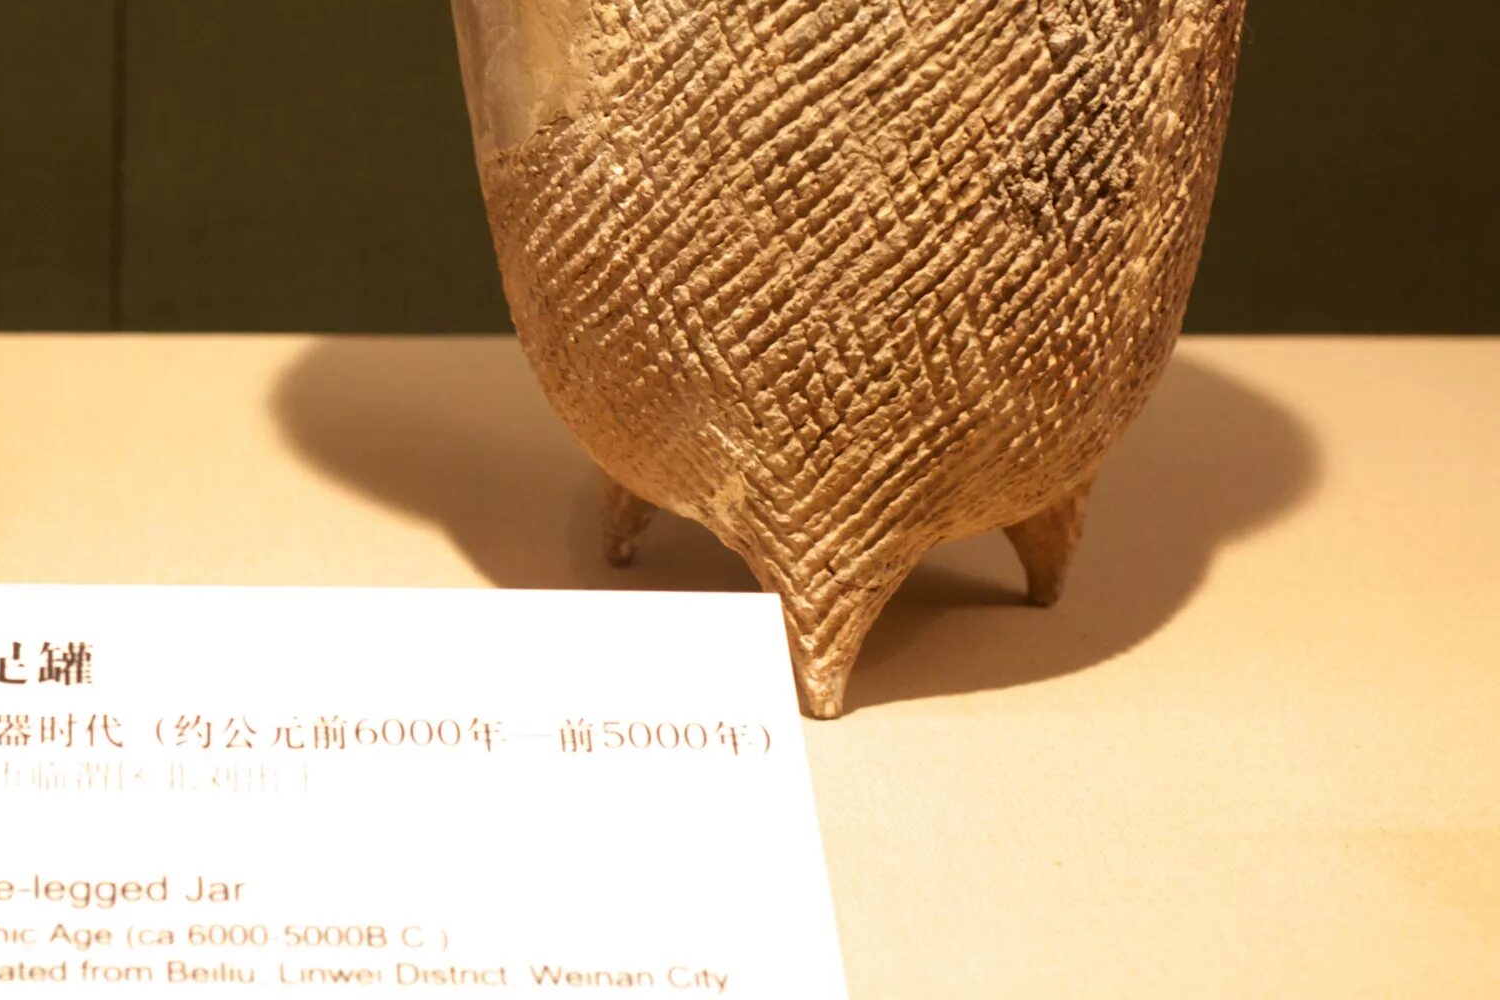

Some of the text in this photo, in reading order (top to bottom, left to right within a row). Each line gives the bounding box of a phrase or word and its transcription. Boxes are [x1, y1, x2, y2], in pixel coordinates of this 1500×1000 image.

[184, 875, 246, 904] Jar
[48, 921, 114, 953] Age
[79, 957, 154, 984] from
[664, 963, 730, 997] City
